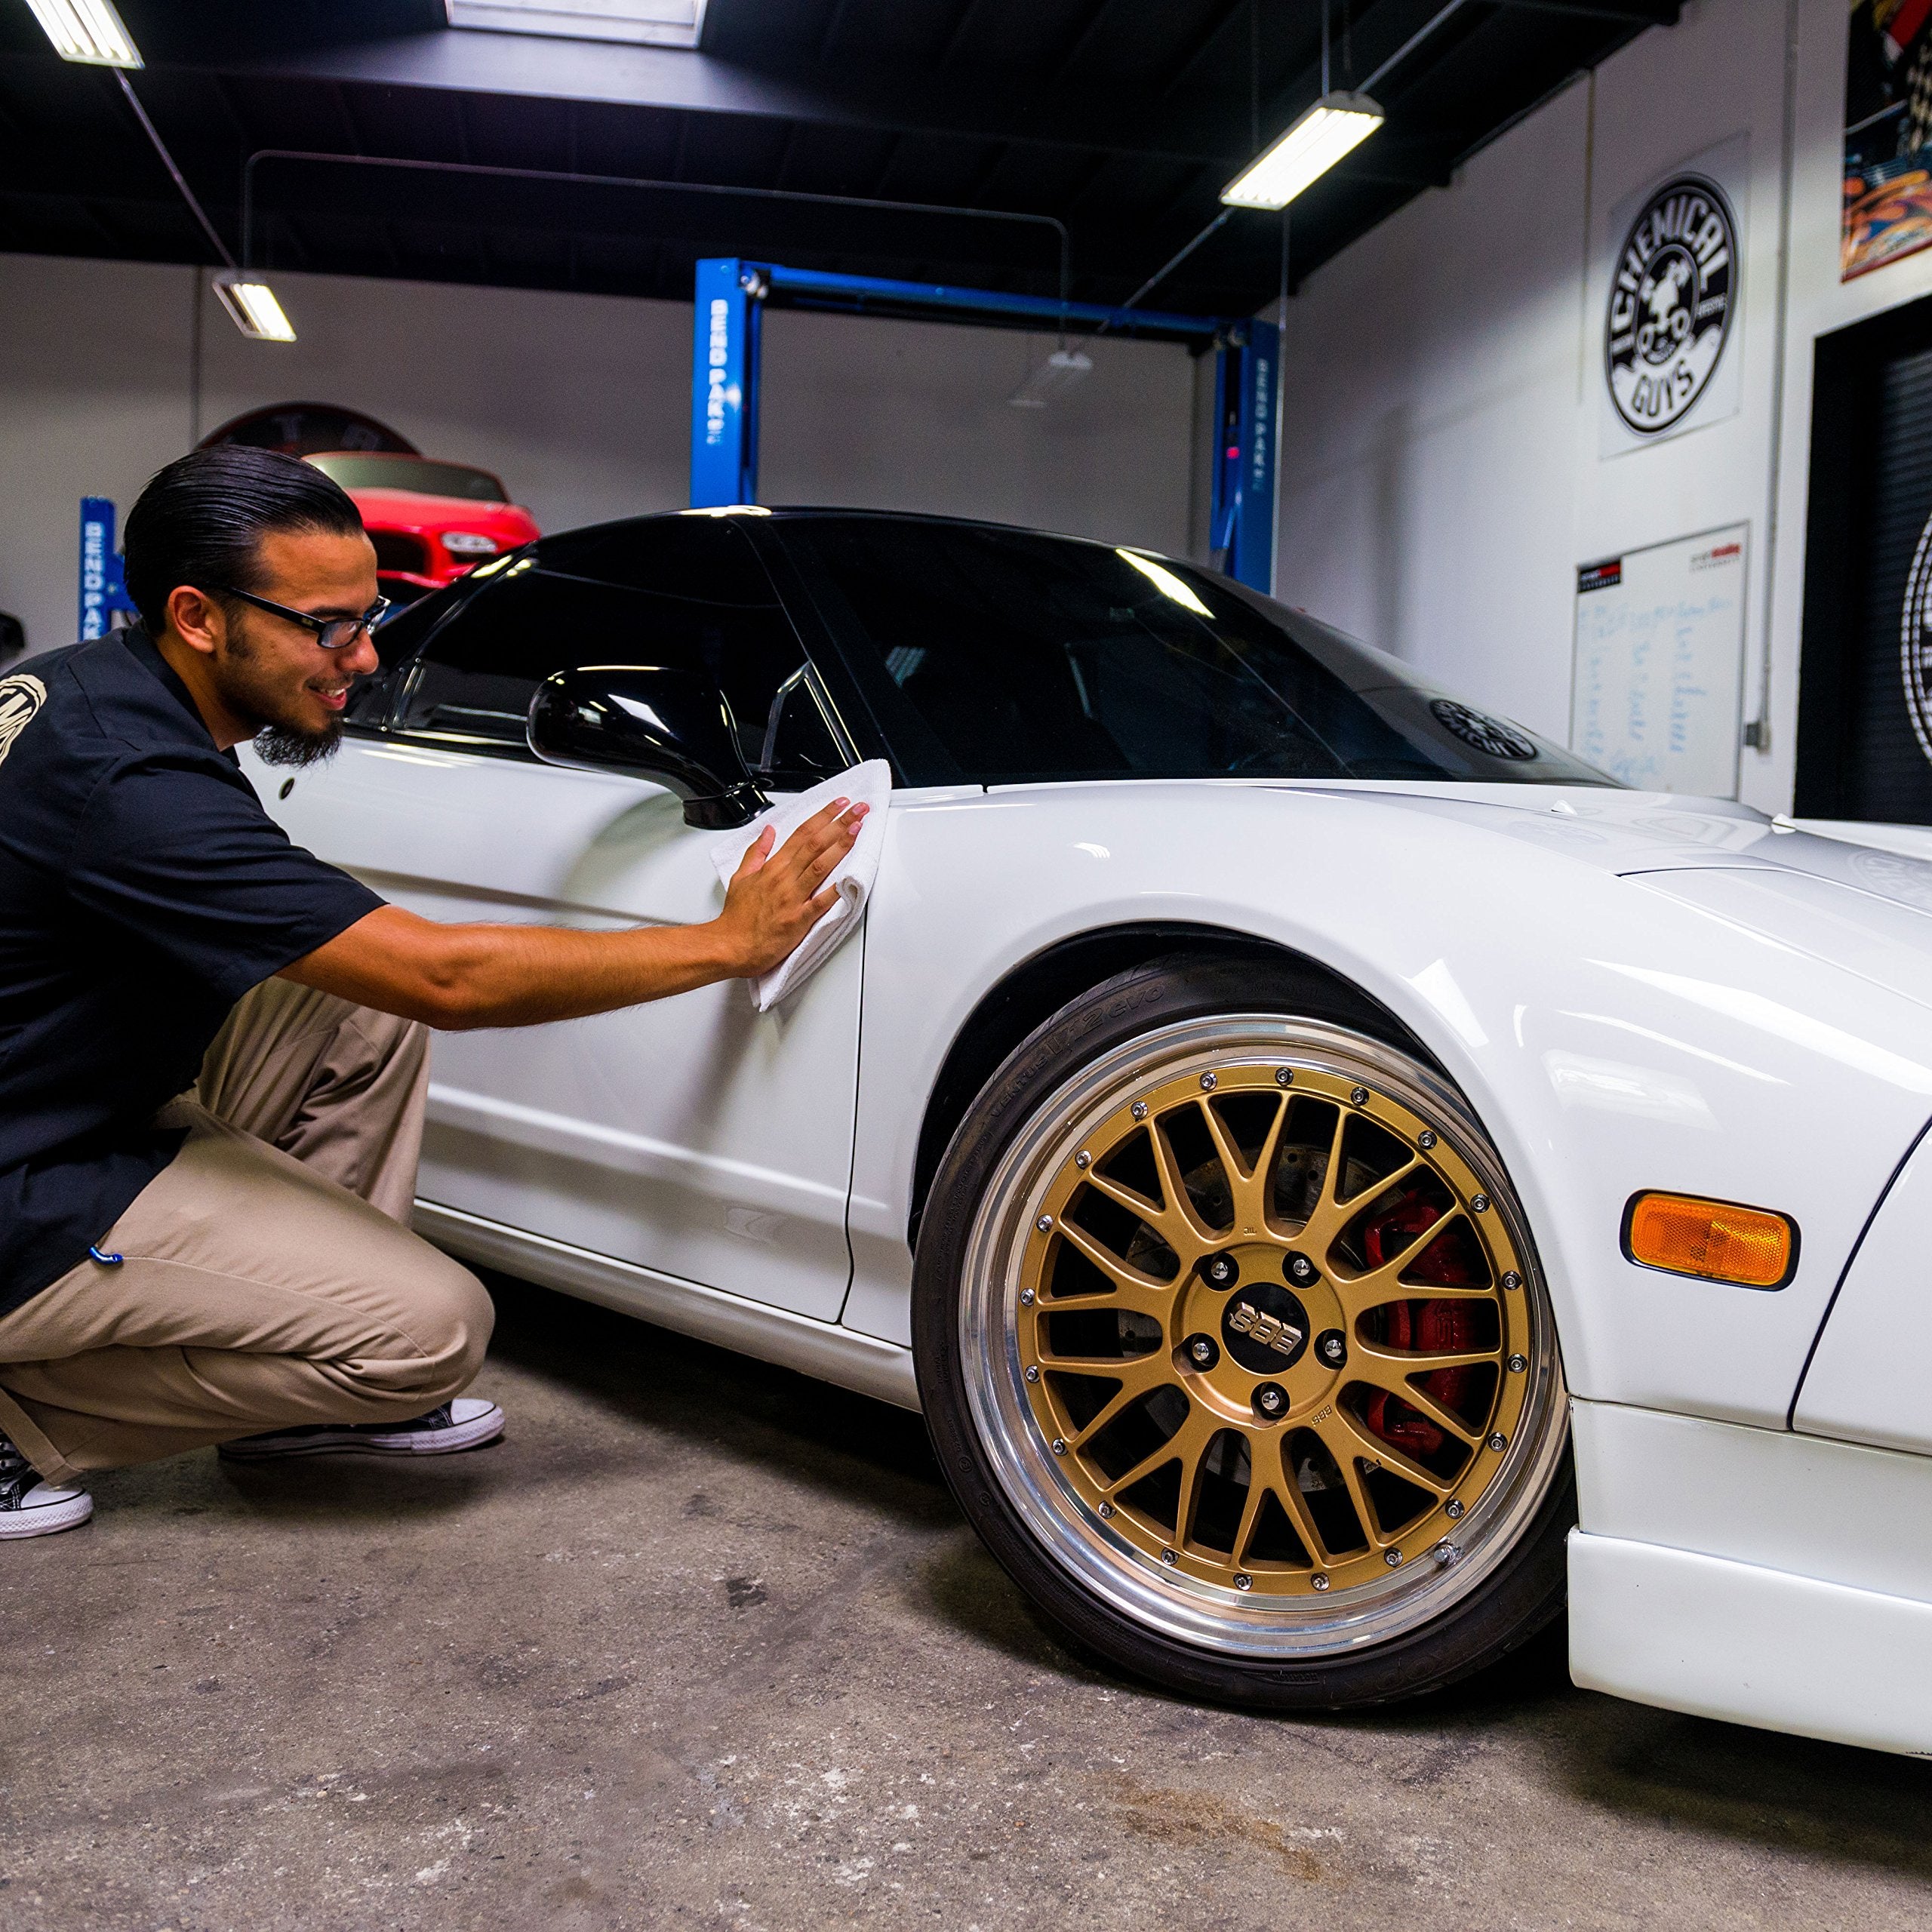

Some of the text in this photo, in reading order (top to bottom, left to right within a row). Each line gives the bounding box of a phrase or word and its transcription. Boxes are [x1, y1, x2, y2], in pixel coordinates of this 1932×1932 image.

[1610, 194, 1728, 332] CHEMICAL
[1631, 359, 1695, 417] GUYS
[991, 1054, 1049, 1118] VENTUS
[1107, 984, 1166, 1018] evo
[1229, 1302, 1303, 1355] BBS
[1311, 1404, 1333, 1427] BBS
